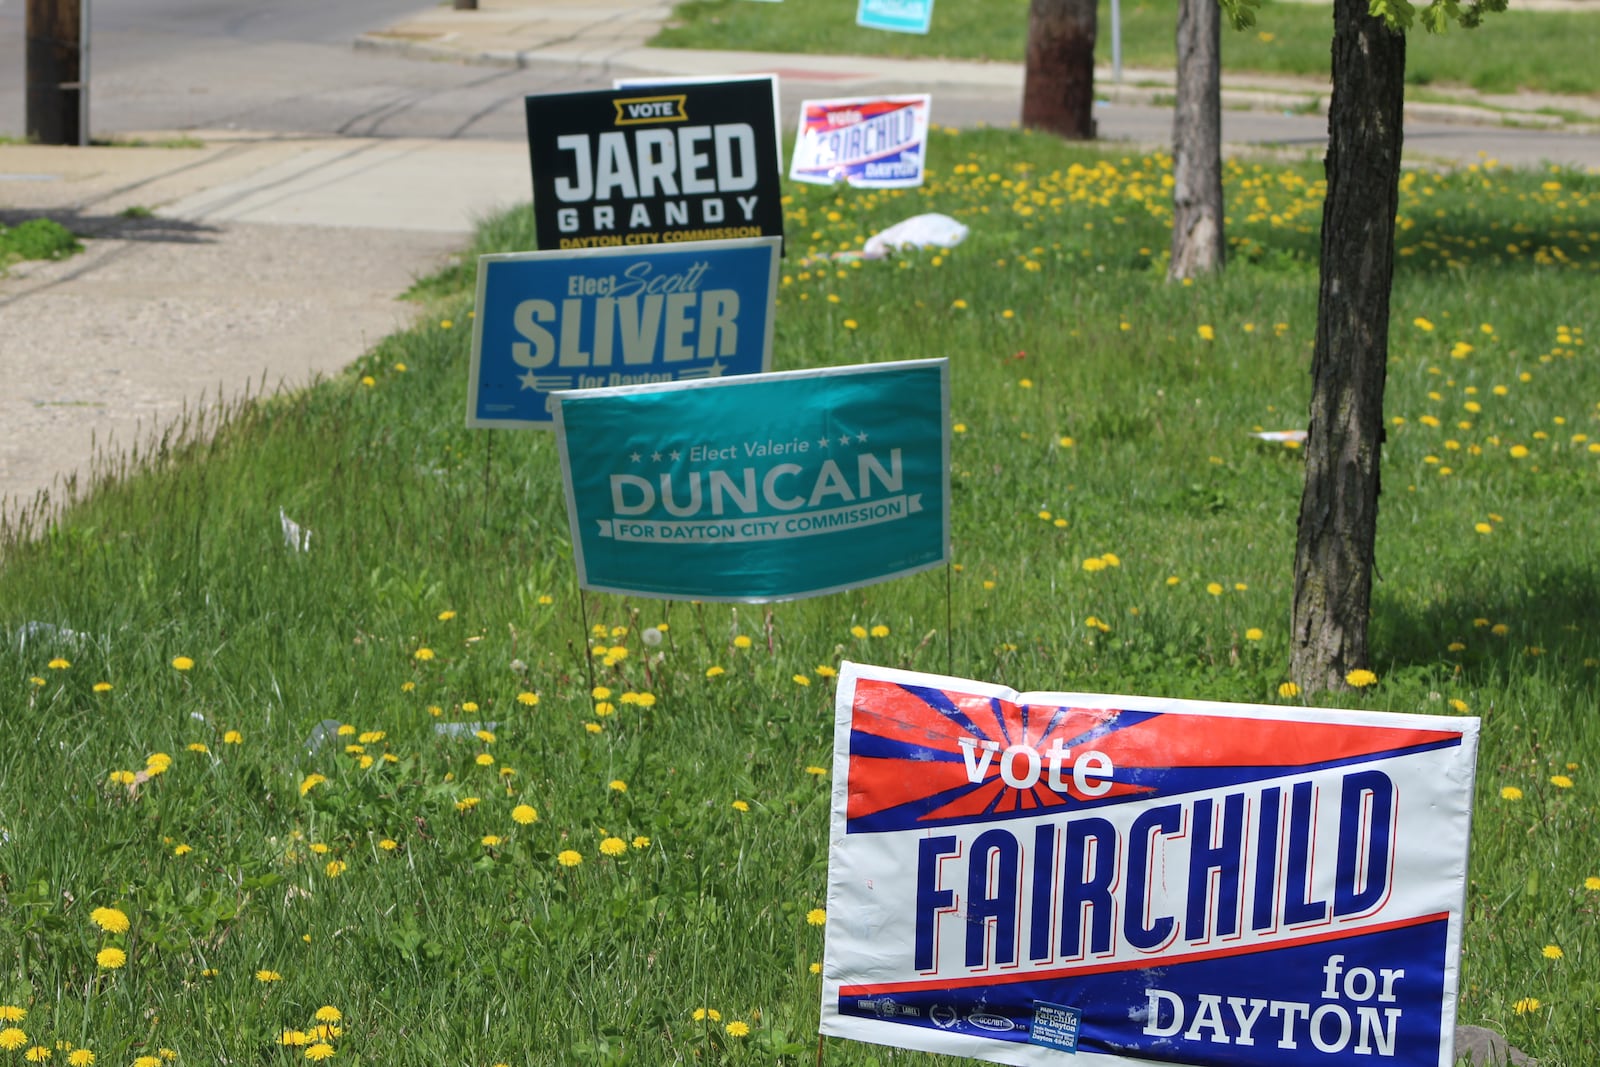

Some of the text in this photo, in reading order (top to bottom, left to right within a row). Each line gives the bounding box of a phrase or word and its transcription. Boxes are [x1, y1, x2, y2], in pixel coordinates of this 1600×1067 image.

[628, 102, 674, 118] VOTE
[554, 123, 759, 203] JARED
[557, 196, 759, 232] GRANDY
[559, 226, 762, 249] DAYTON CITY COMMISSION
[568, 261, 712, 300] Elect Scott
[512, 289, 740, 369] SLIVER
[578, 373, 605, 390] for
[690, 439, 809, 463] Elect Valerie
[610, 448, 904, 518] DUNCAN
[619, 501, 902, 540] FOR DAYTON CITY COMMISSION
[958, 737, 1113, 796] vote
[914, 770, 1398, 976] FAIRCHILD
[1323, 955, 1405, 1003] for
[1034, 1016, 1048, 1025] For
[1049, 1020, 1076, 1032] Dayton
[1035, 1010, 1077, 1026] Fairchild
[1144, 988, 1402, 1057] DAYTON
